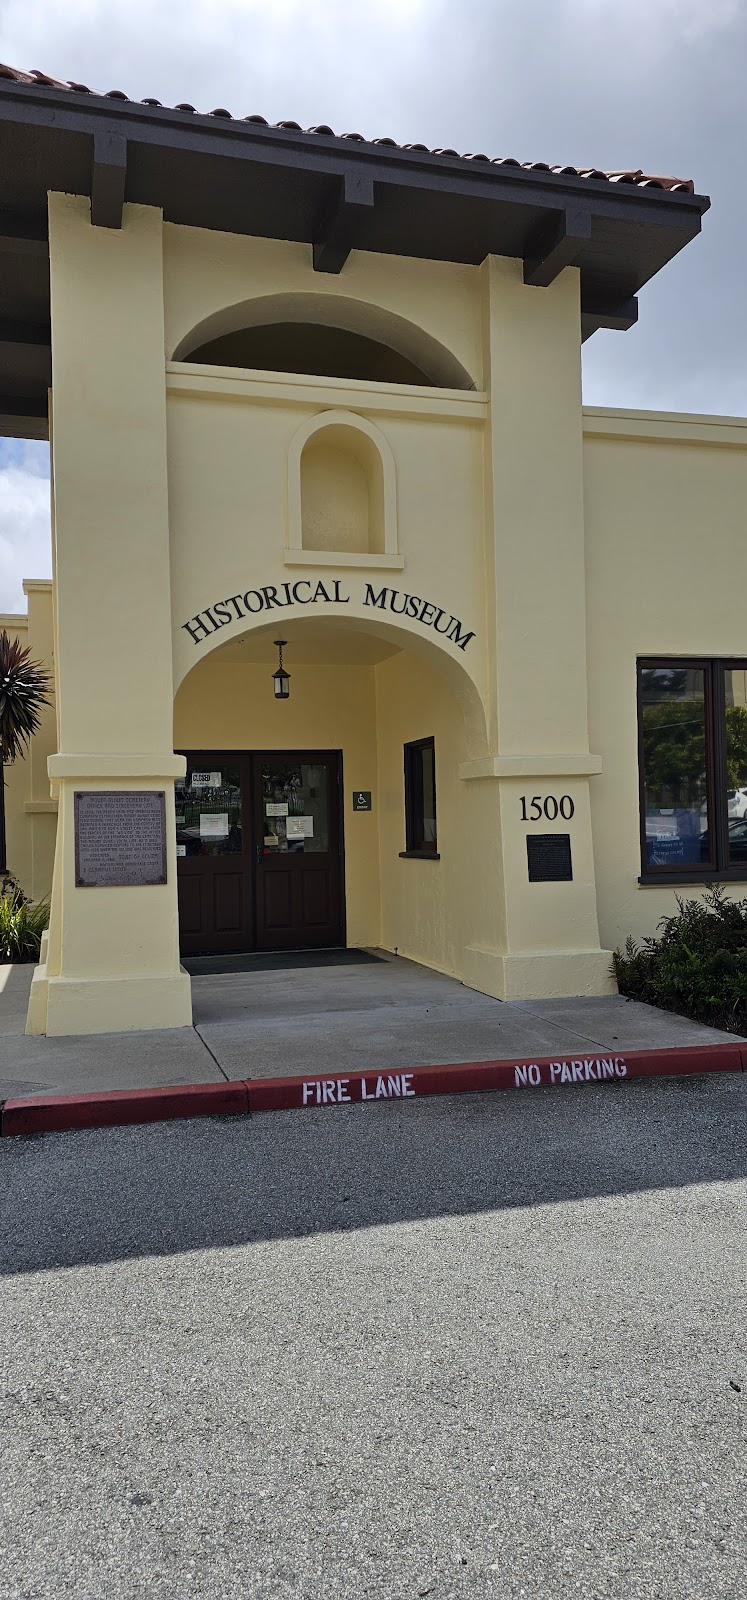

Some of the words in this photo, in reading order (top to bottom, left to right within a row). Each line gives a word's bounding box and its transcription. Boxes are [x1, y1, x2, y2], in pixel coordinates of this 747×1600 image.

[181, 580, 350, 645] HISTORICAL
[362, 583, 477, 652] MUSEUM
[519, 795, 575, 821] 1500
[514, 1064, 541, 1088] NO
[549, 1058, 627, 1084] PARKING
[302, 1079, 351, 1104] FIRE
[361, 1073, 415, 1100] LANE
